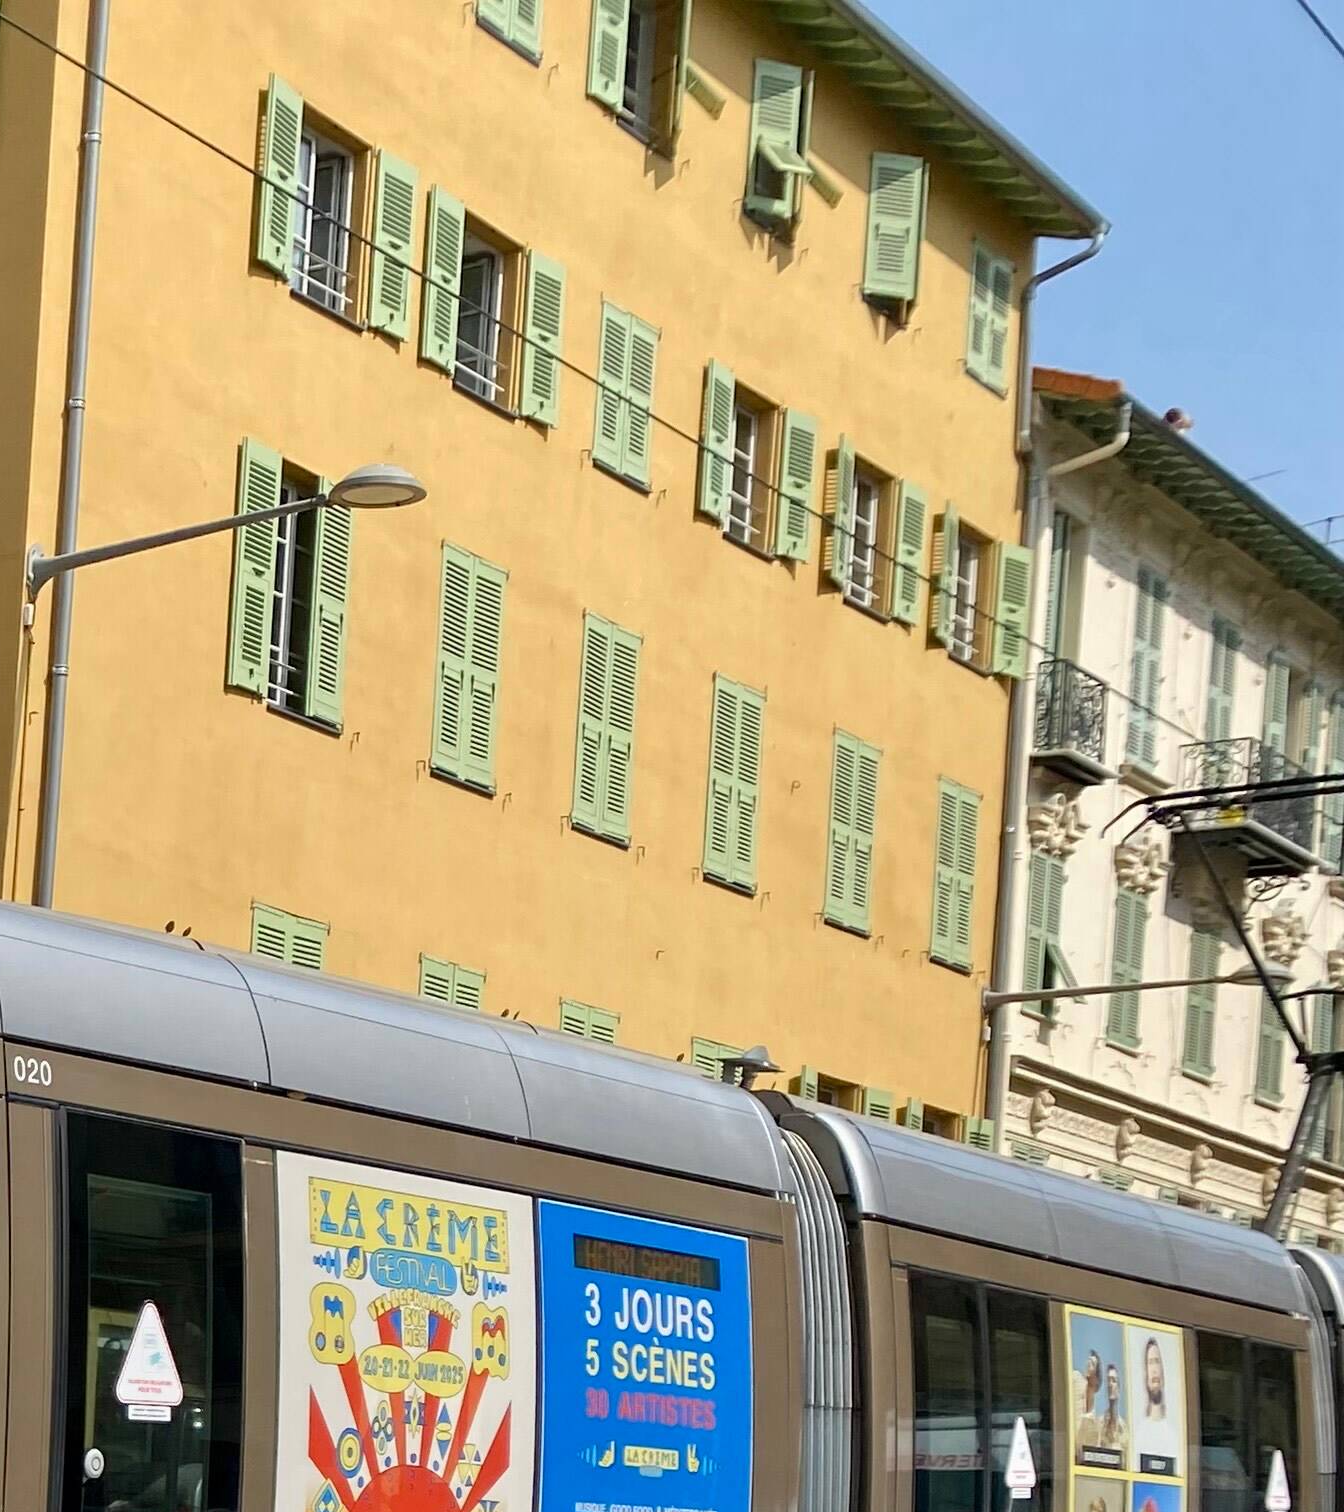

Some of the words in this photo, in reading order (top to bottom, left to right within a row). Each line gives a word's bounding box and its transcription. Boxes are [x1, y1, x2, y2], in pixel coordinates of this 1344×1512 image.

[14, 1055, 52, 1086] 020
[320, 1190, 366, 1240] LA
[376, 1252, 454, 1293] FESTIVAL
[585, 1282, 602, 1327] 3
[615, 1287, 715, 1343] JOURS
[415, 1361, 439, 1382] JUIN
[440, 1364, 464, 1385] 2025
[586, 1338, 600, 1377] 5
[612, 1336, 716, 1391] SCÈNES
[586, 1386, 610, 1419] 30
[618, 1391, 717, 1431] ARTISTES
